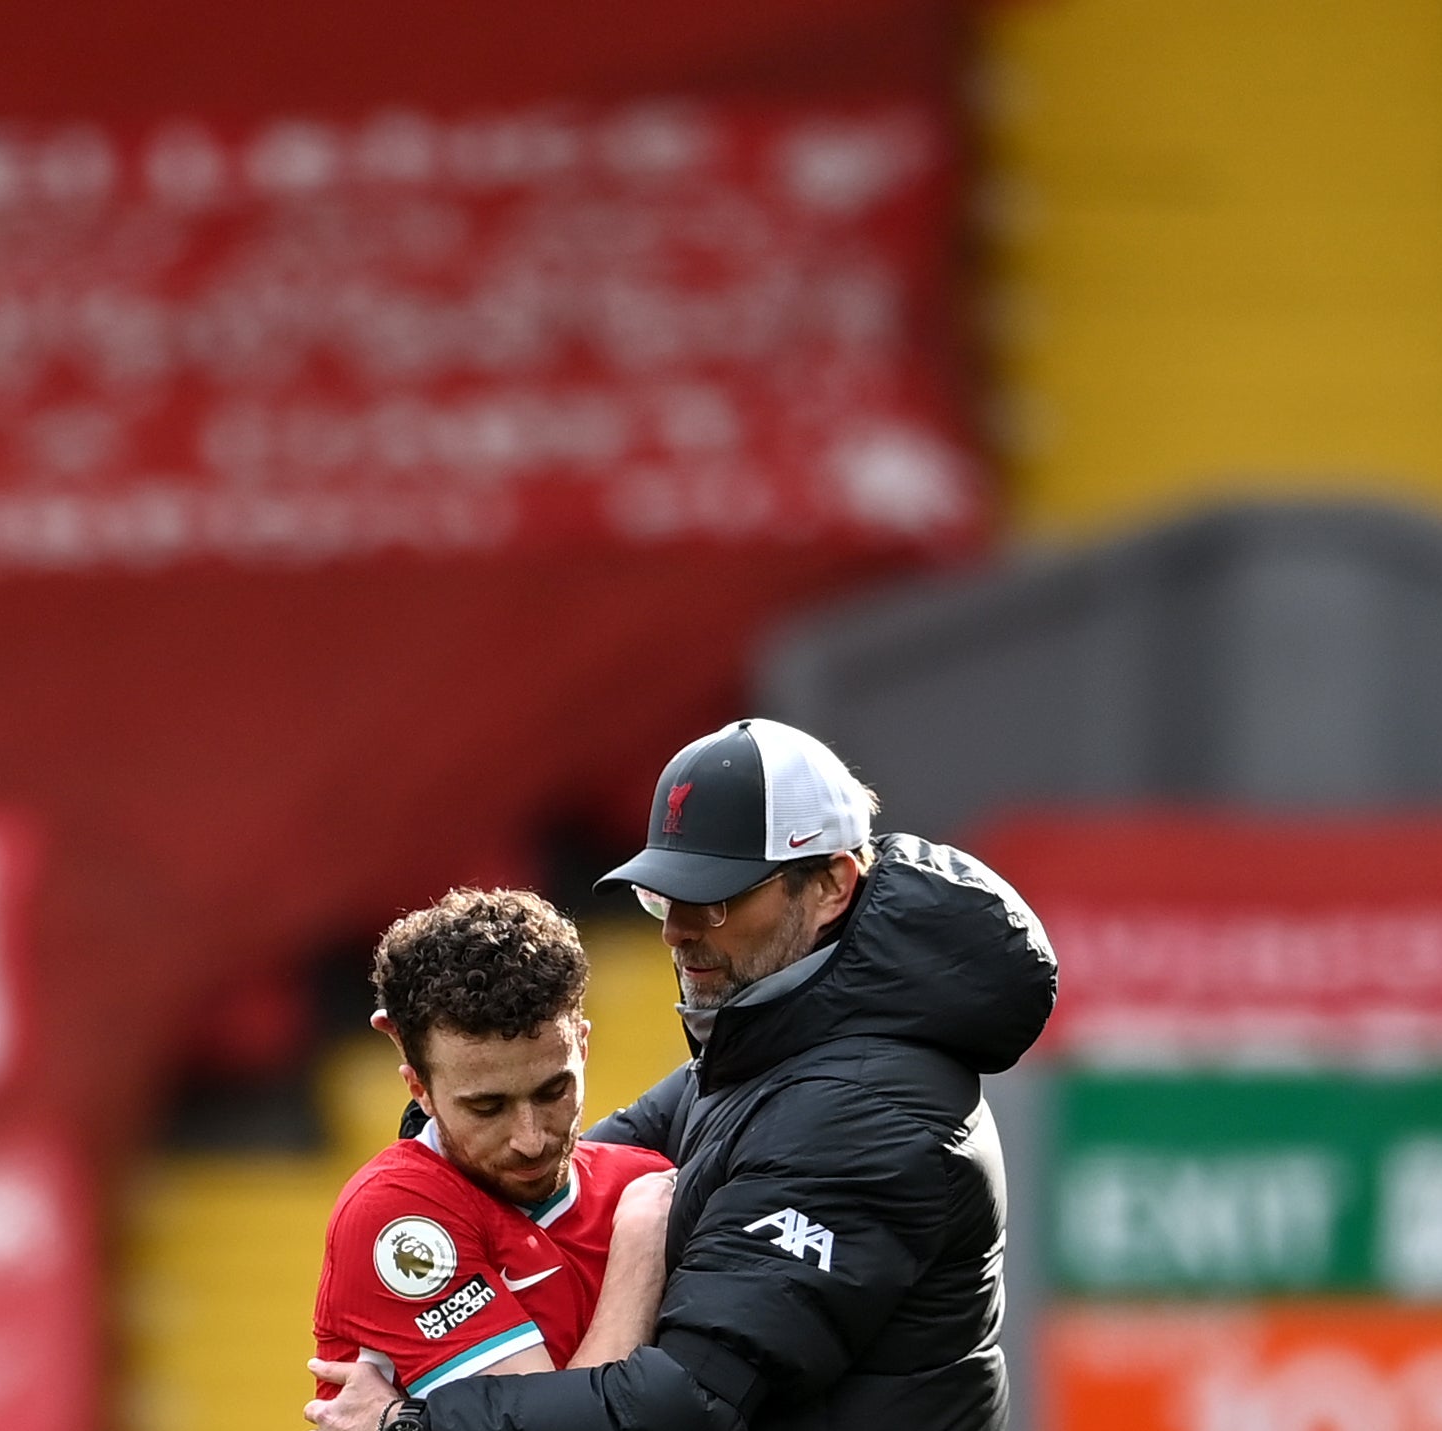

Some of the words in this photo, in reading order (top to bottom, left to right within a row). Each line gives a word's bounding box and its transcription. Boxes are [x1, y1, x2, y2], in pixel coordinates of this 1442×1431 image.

[742, 1206, 835, 1273] AXA
[1057, 1150, 1335, 1286] EXIT
[414, 1309, 442, 1333] No
[439, 1280, 482, 1316] room
[422, 1320, 448, 1339] for
[446, 1287, 496, 1328] racism
